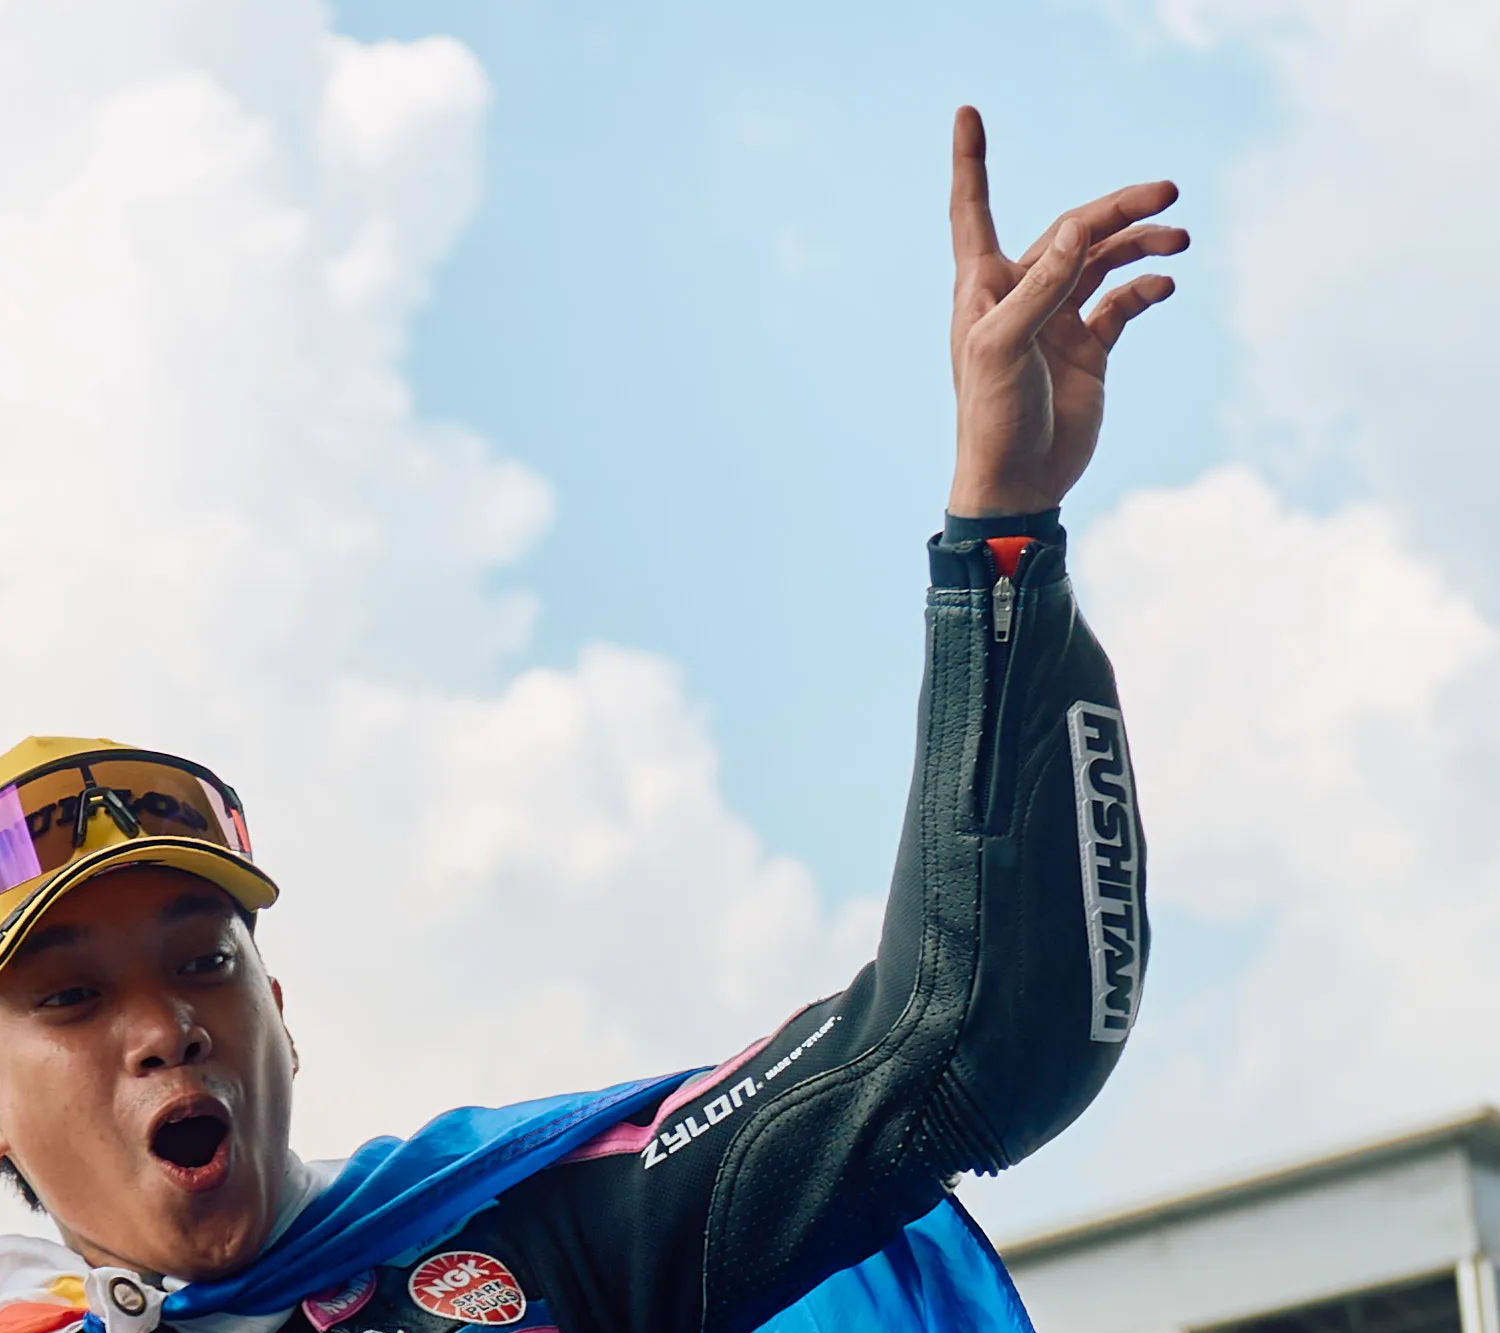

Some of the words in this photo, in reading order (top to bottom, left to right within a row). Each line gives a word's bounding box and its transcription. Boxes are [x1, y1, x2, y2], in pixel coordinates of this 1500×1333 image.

[422, 1259, 490, 1299] NGK
[452, 1279, 505, 1308] SPARK
[466, 1291, 519, 1317] PLUGS
